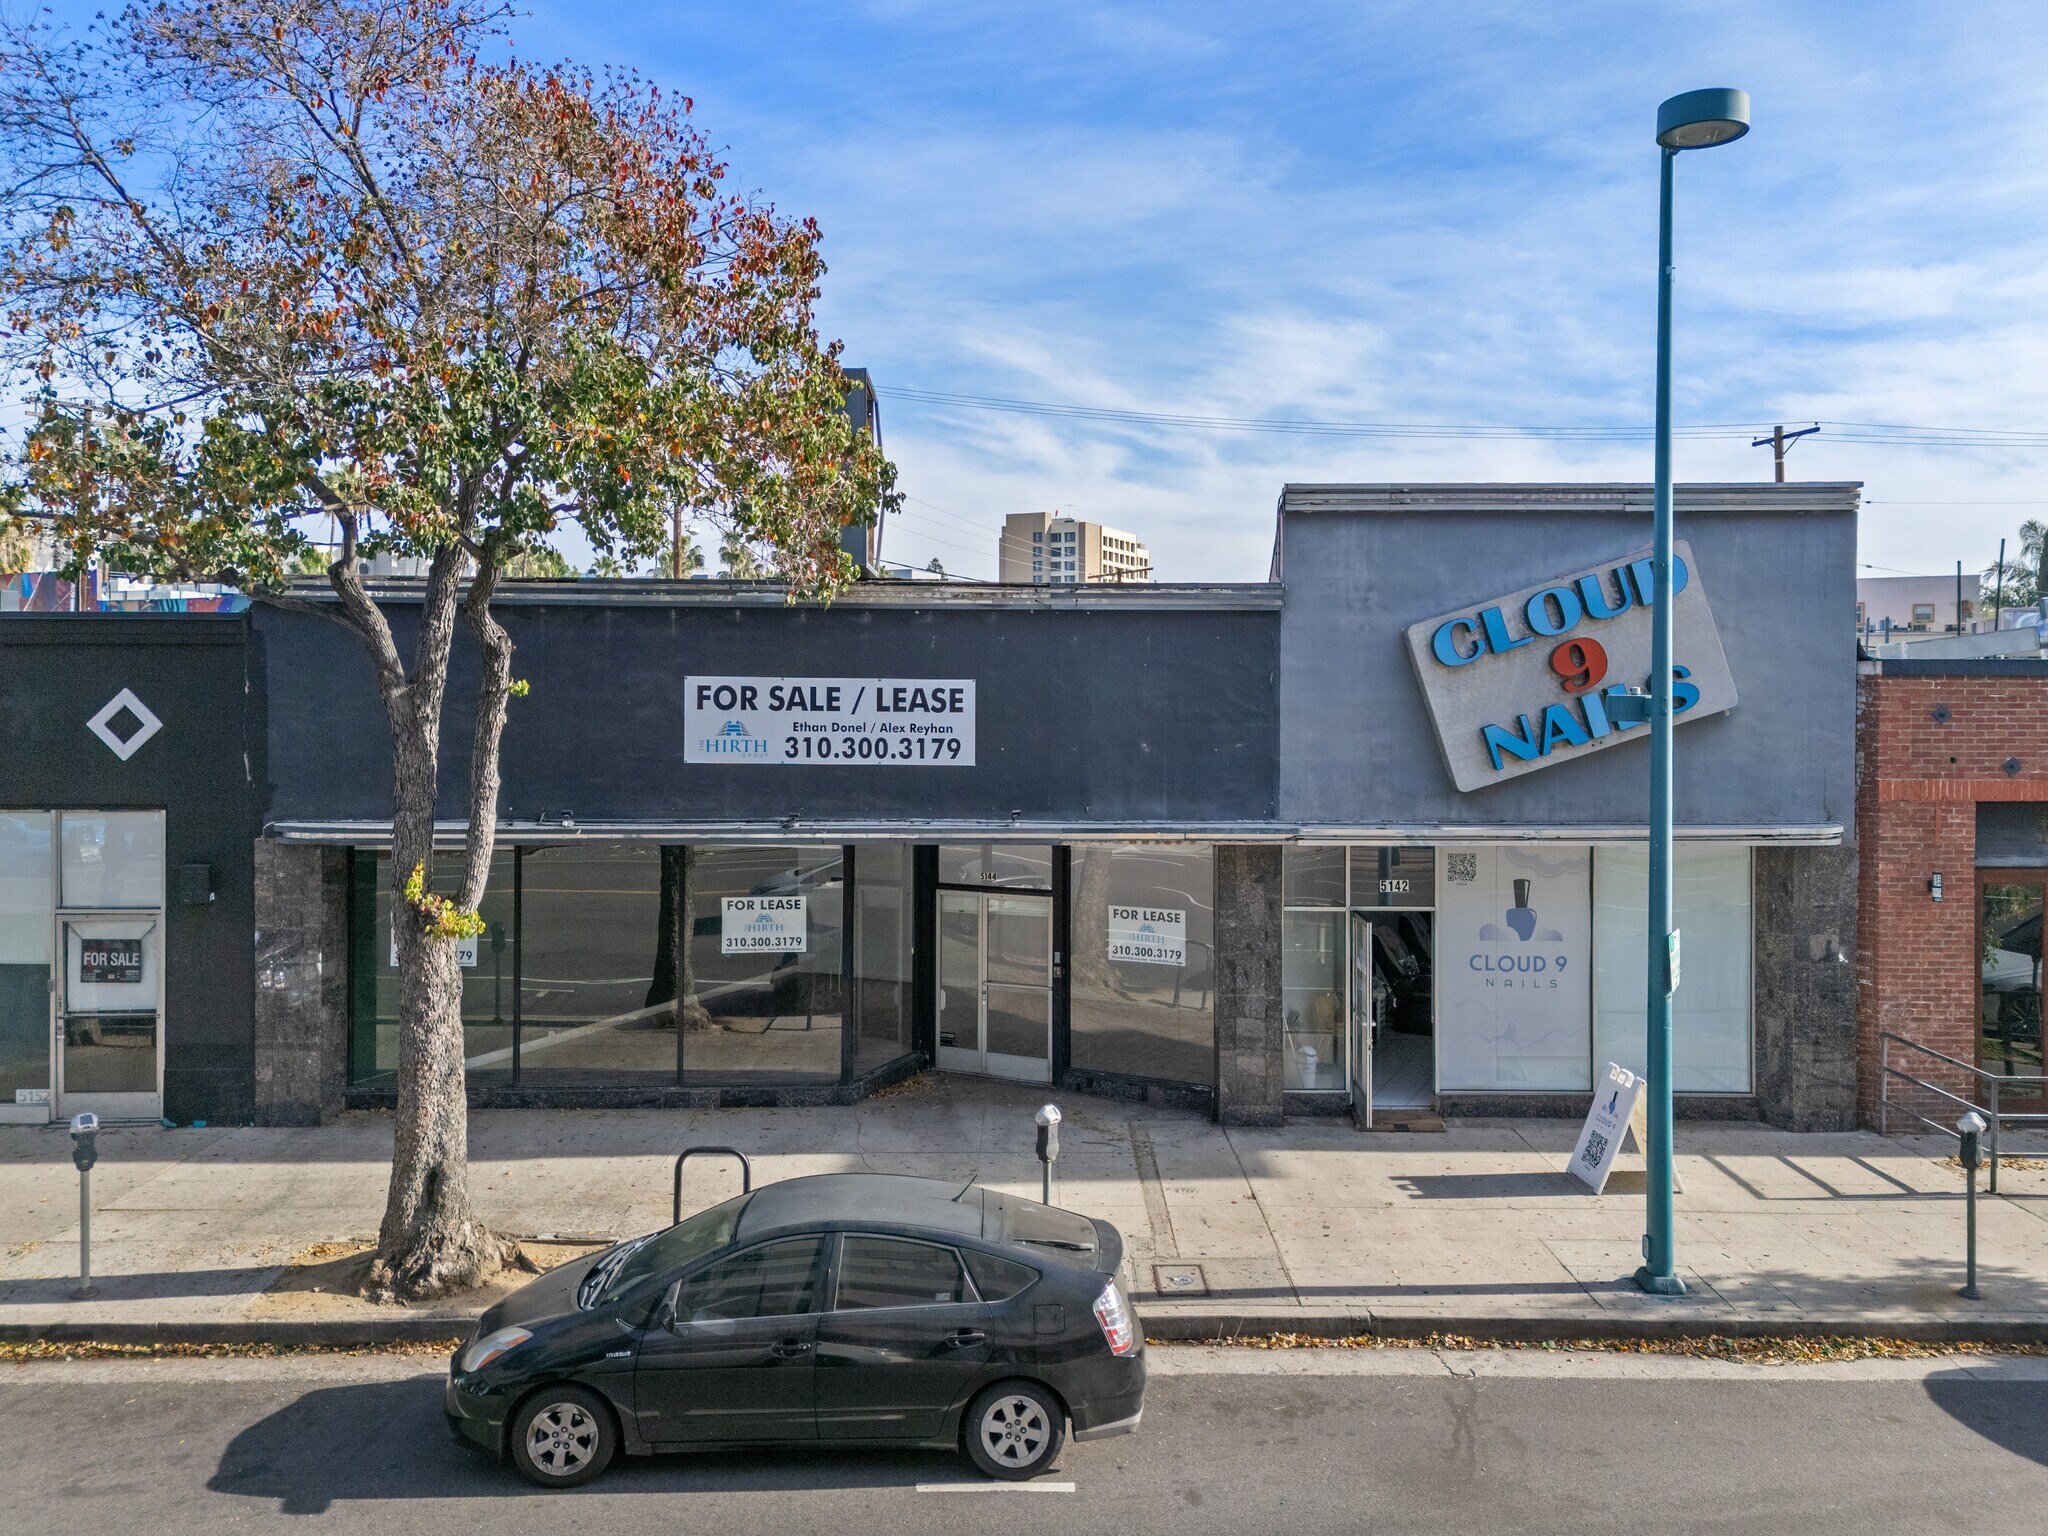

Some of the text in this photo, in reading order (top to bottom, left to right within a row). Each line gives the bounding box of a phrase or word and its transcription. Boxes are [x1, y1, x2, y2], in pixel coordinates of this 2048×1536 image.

[1431, 554, 1688, 666] CLOUD
[1549, 637, 1608, 692] 9
[696, 685, 964, 715] FOR SALE / LEASE
[793, 722, 953, 735] Ethan Donel / Alex Reyhan
[706, 739, 767, 753] HIRTH
[785, 737, 961, 759] 310.300.3179
[980, 872, 997, 880] 5144
[1380, 880, 1409, 892] 5142
[727, 899, 801, 910] FOR LEASE
[1113, 909, 1181, 923] FOR LEASE
[748, 923, 784, 932] HIRTH
[726, 937, 802, 947] 310.300.3179
[1132, 933, 1164, 943] HIRTH
[83, 952, 140, 966] FOR SALE
[1112, 945, 1182, 960] 310.300.3179
[1469, 954, 1568, 973] CLOUD 9
[1485, 978, 1558, 989] NAILS
[18, 1090, 50, 1103] 5152
[1596, 1113, 1612, 1128] CLOUD
